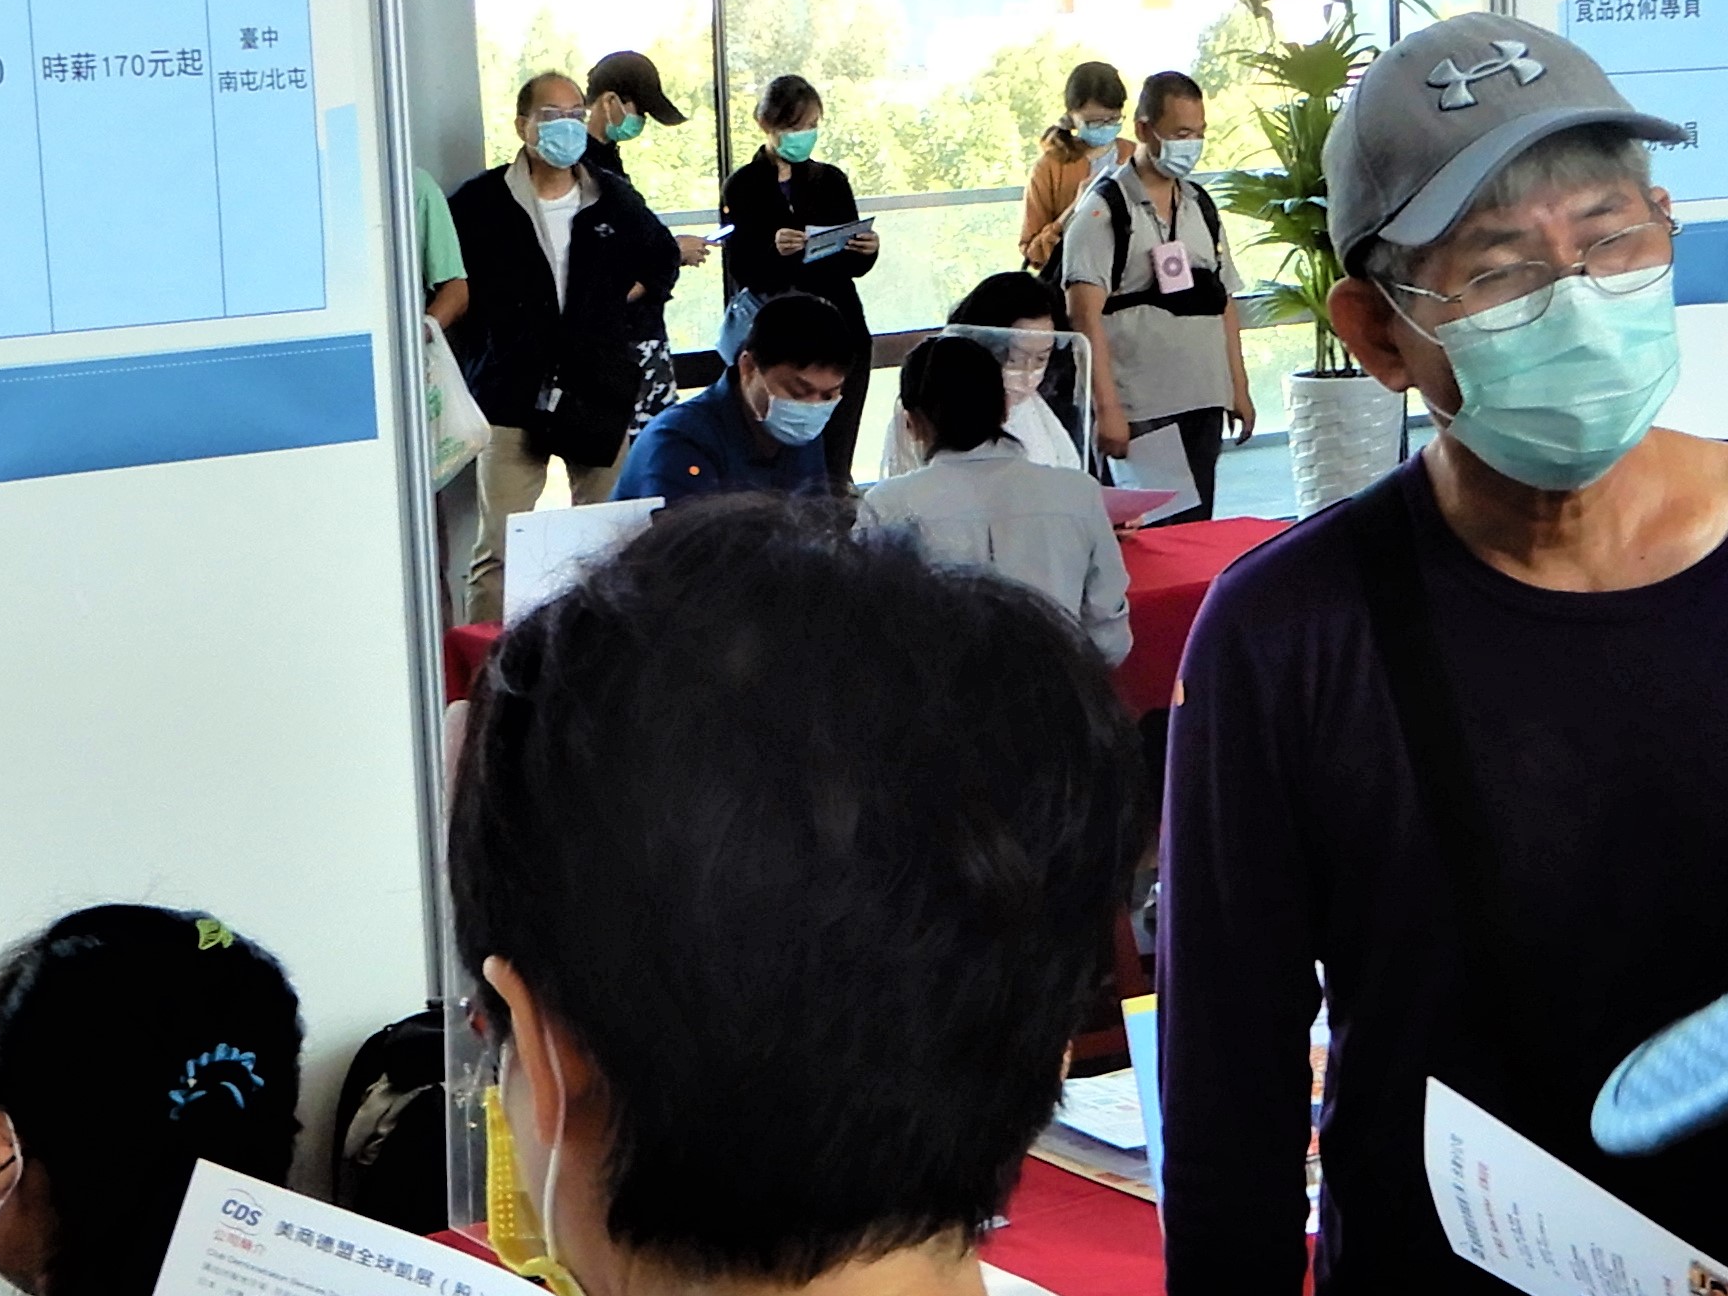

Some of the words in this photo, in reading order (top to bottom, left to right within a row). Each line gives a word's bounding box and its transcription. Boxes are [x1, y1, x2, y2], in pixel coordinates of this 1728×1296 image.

[239, 25, 280, 51] 臺中
[40, 47, 205, 85] 時薪170元起
[217, 65, 308, 93] 南屯/北屯
[220, 1196, 263, 1229] CDS
